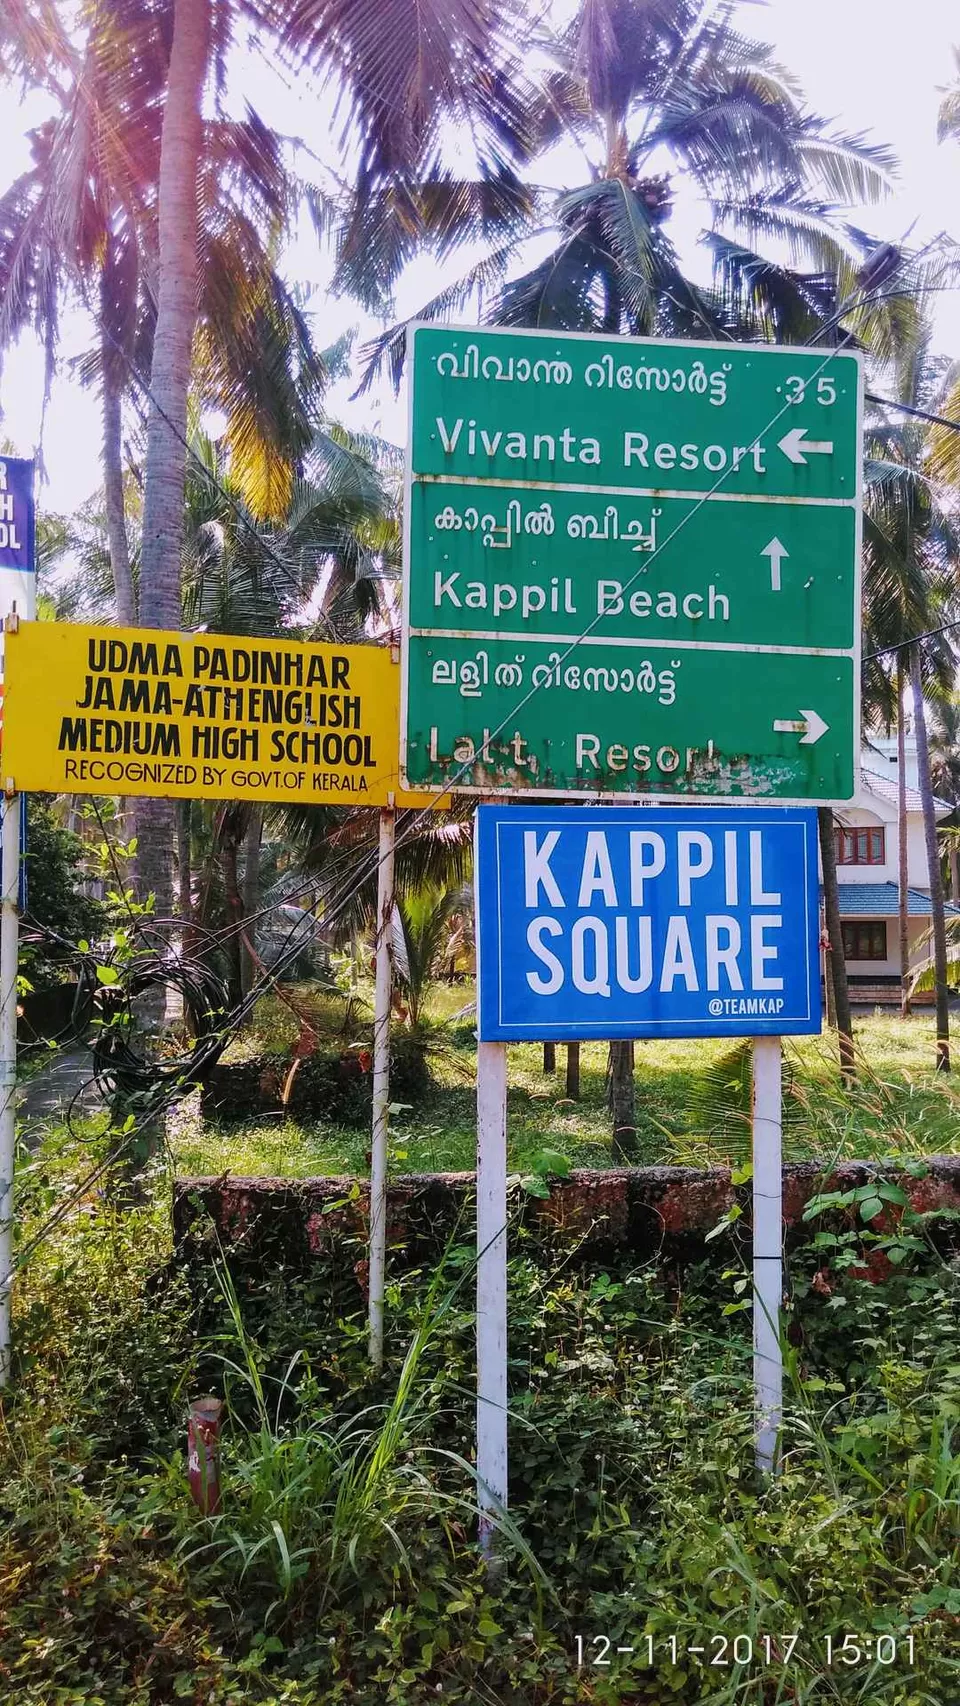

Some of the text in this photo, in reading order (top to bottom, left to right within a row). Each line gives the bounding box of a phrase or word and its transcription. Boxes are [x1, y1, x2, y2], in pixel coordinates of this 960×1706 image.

[436, 344, 573, 385] വിവാന്ത
[435, 417, 767, 474] Vivanta Resort
[433, 571, 730, 621] Kappil Beach
[88, 638, 350, 690] UDMA PADINHAR
[248, 688, 361, 729] ENGLISH
[58, 717, 376, 768] MEDIUM HIGH SCHOOL
[65, 759, 197, 785] RECOGNIZED
[203, 766, 227, 786] BY
[313, 773, 368, 792] KERALA
[524, 831, 782, 908] KAPPIL
[526, 914, 784, 998] SQUARE
[708, 998, 784, 1016] @TEAMKAP
